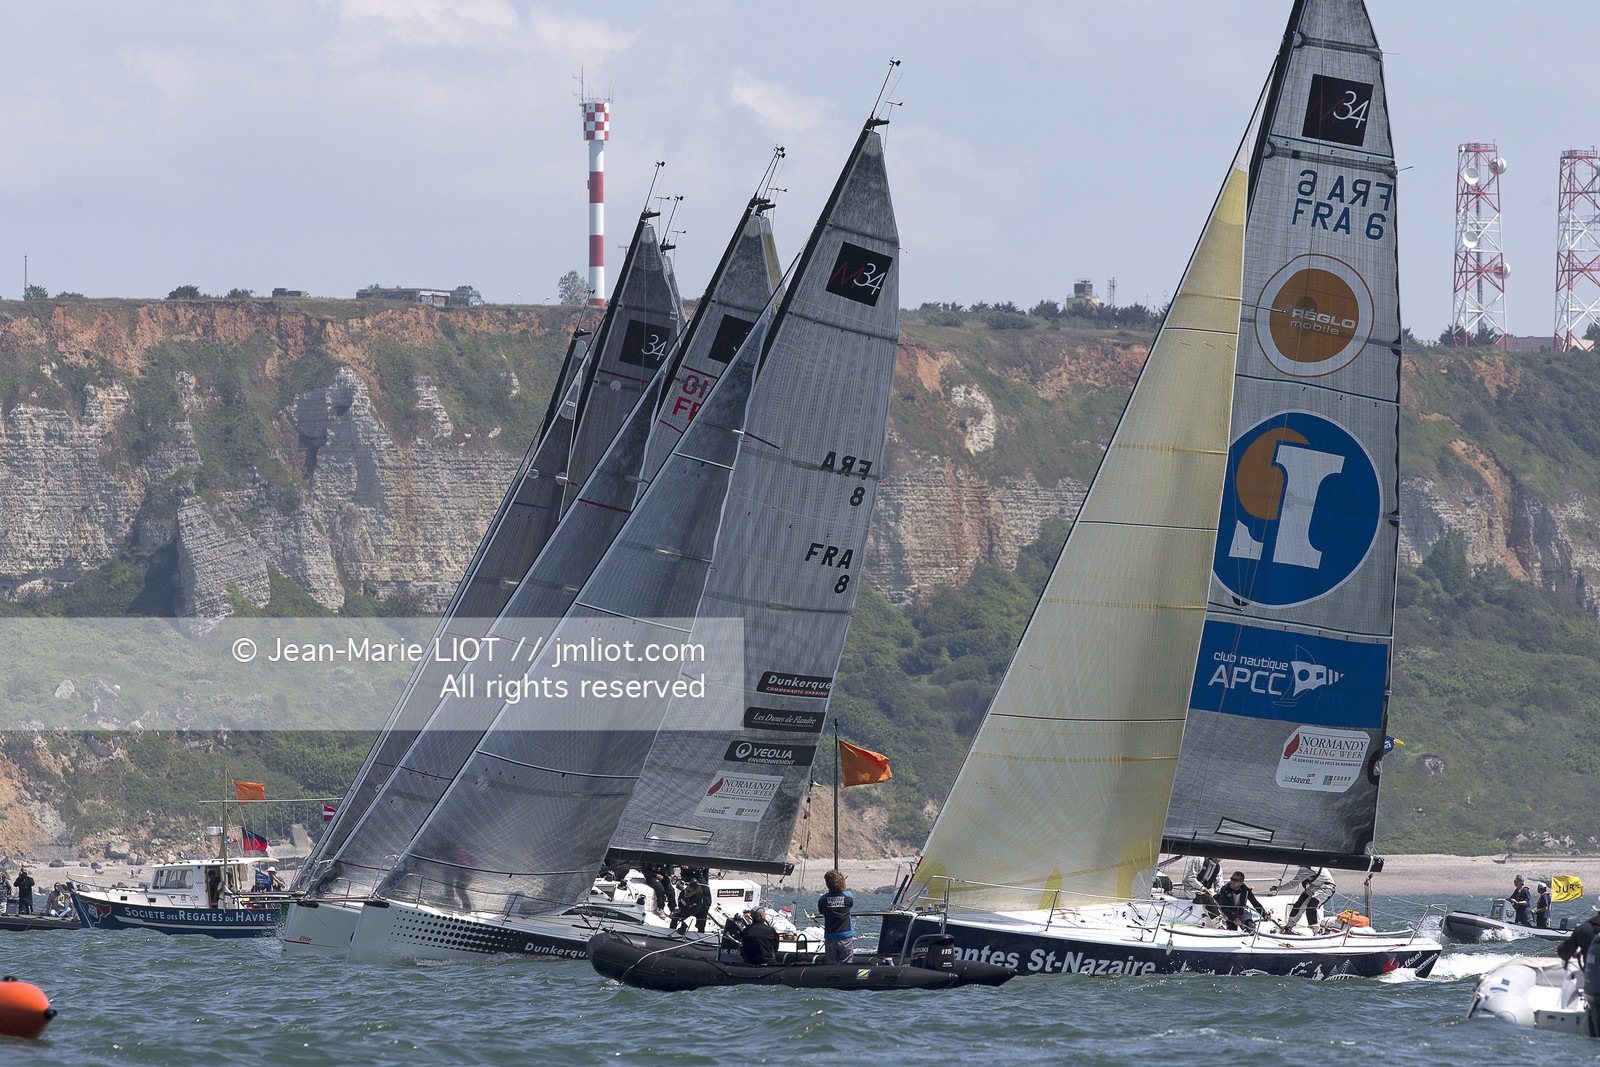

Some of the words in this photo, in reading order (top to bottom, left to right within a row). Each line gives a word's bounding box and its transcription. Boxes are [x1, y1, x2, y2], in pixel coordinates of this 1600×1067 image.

[1291, 198, 1351, 235] FRA
[1366, 213, 1387, 240] 6
[830, 261, 886, 295] M34
[1292, 308, 1356, 329] RÉGLO
[1289, 320, 1340, 335] mobile
[804, 542, 854, 569] FRA
[833, 574, 850, 594] 8
[1213, 651, 1237, 663] club
[1239, 655, 1289, 672] nautique
[768, 675, 832, 691] Dunkerque
[1208, 664, 1287, 696] APCC
[1300, 736, 1368, 751] NORMANDY
[753, 748, 793, 759] VEOLIA
[1298, 746, 1336, 757] SAILING
[1340, 751, 1364, 759] WEEK
[747, 757, 796, 765] ENVIRONNEMENT
[720, 787, 751, 795] SAILING
[723, 779, 778, 791] NORMANDY
[124, 907, 165, 920] SOCIETE
[178, 910, 223, 922] REGATES
[235, 911, 272, 922] HAVRE
[524, 942, 589, 959] Dunkerqu
[953, 945, 1020, 968] antes
[1027, 949, 1156, 977] St-Nazaire
